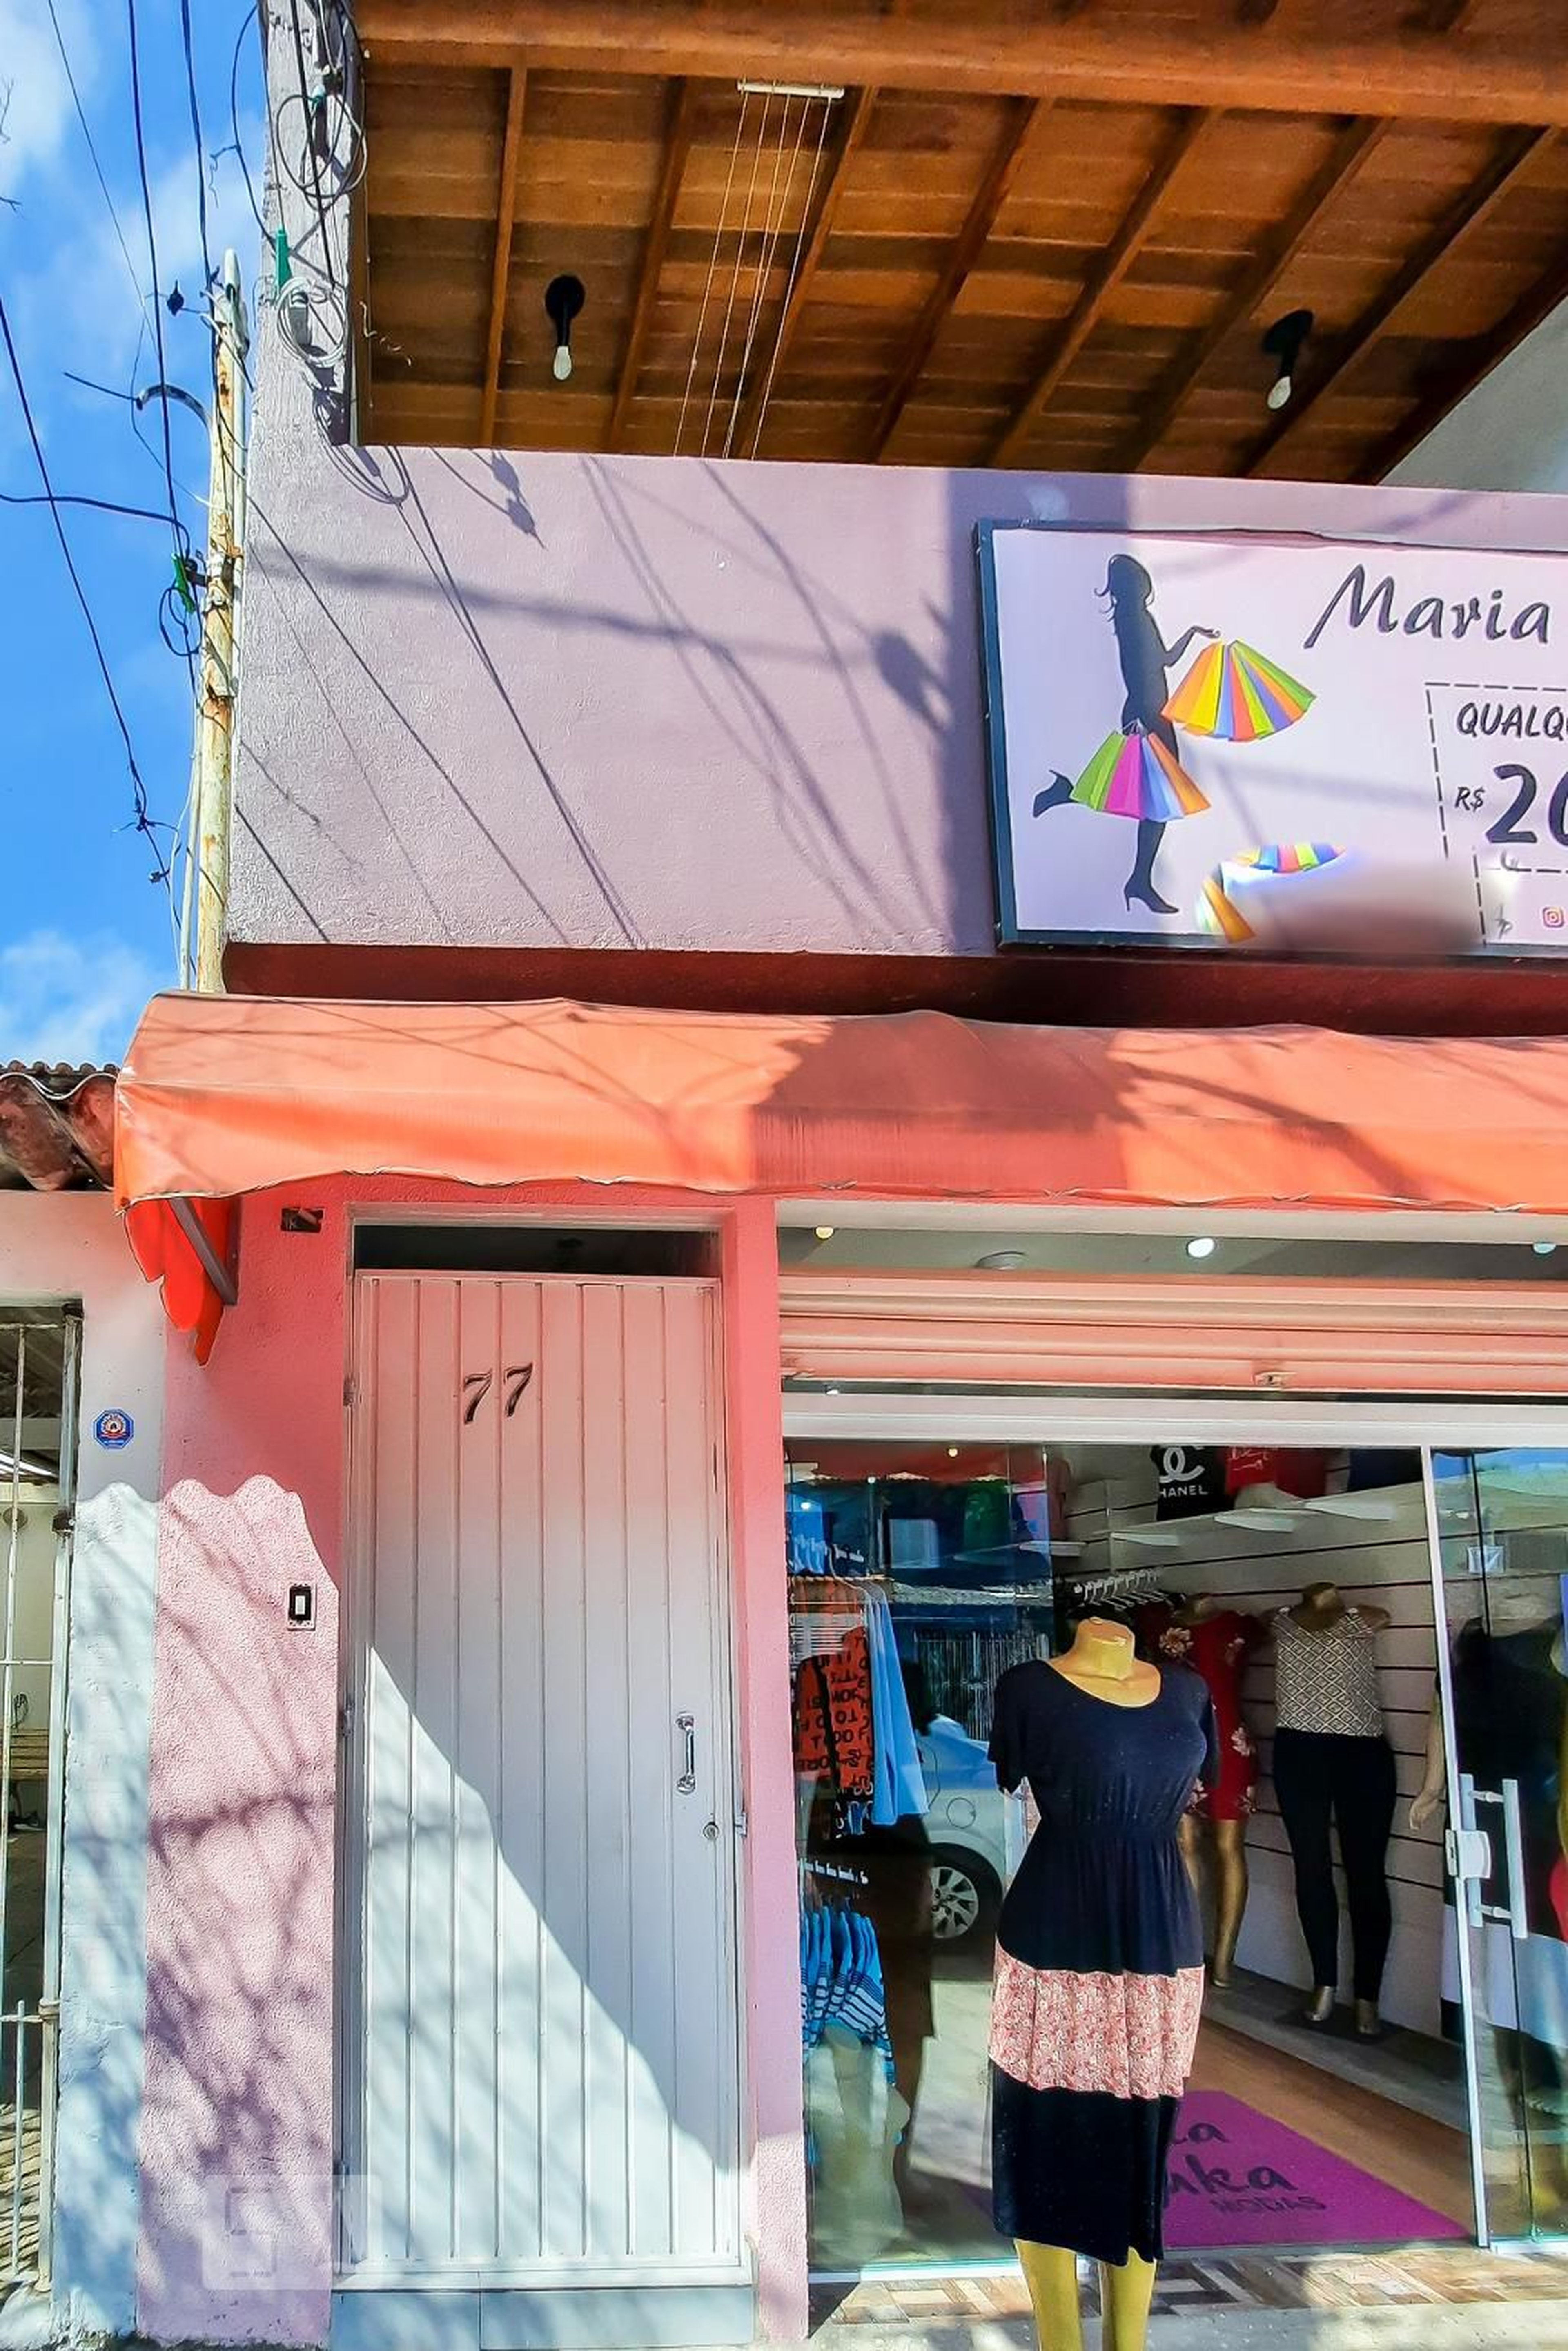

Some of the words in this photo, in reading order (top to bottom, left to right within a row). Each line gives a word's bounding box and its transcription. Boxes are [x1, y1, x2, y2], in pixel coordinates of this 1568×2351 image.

[1303, 563, 1550, 649] Maria
[1457, 702, 1568, 741] QUALQ
[1454, 786, 1486, 812] R$
[463, 1362, 533, 1425] 77
[1160, 1484, 1209, 1498] HANEL
